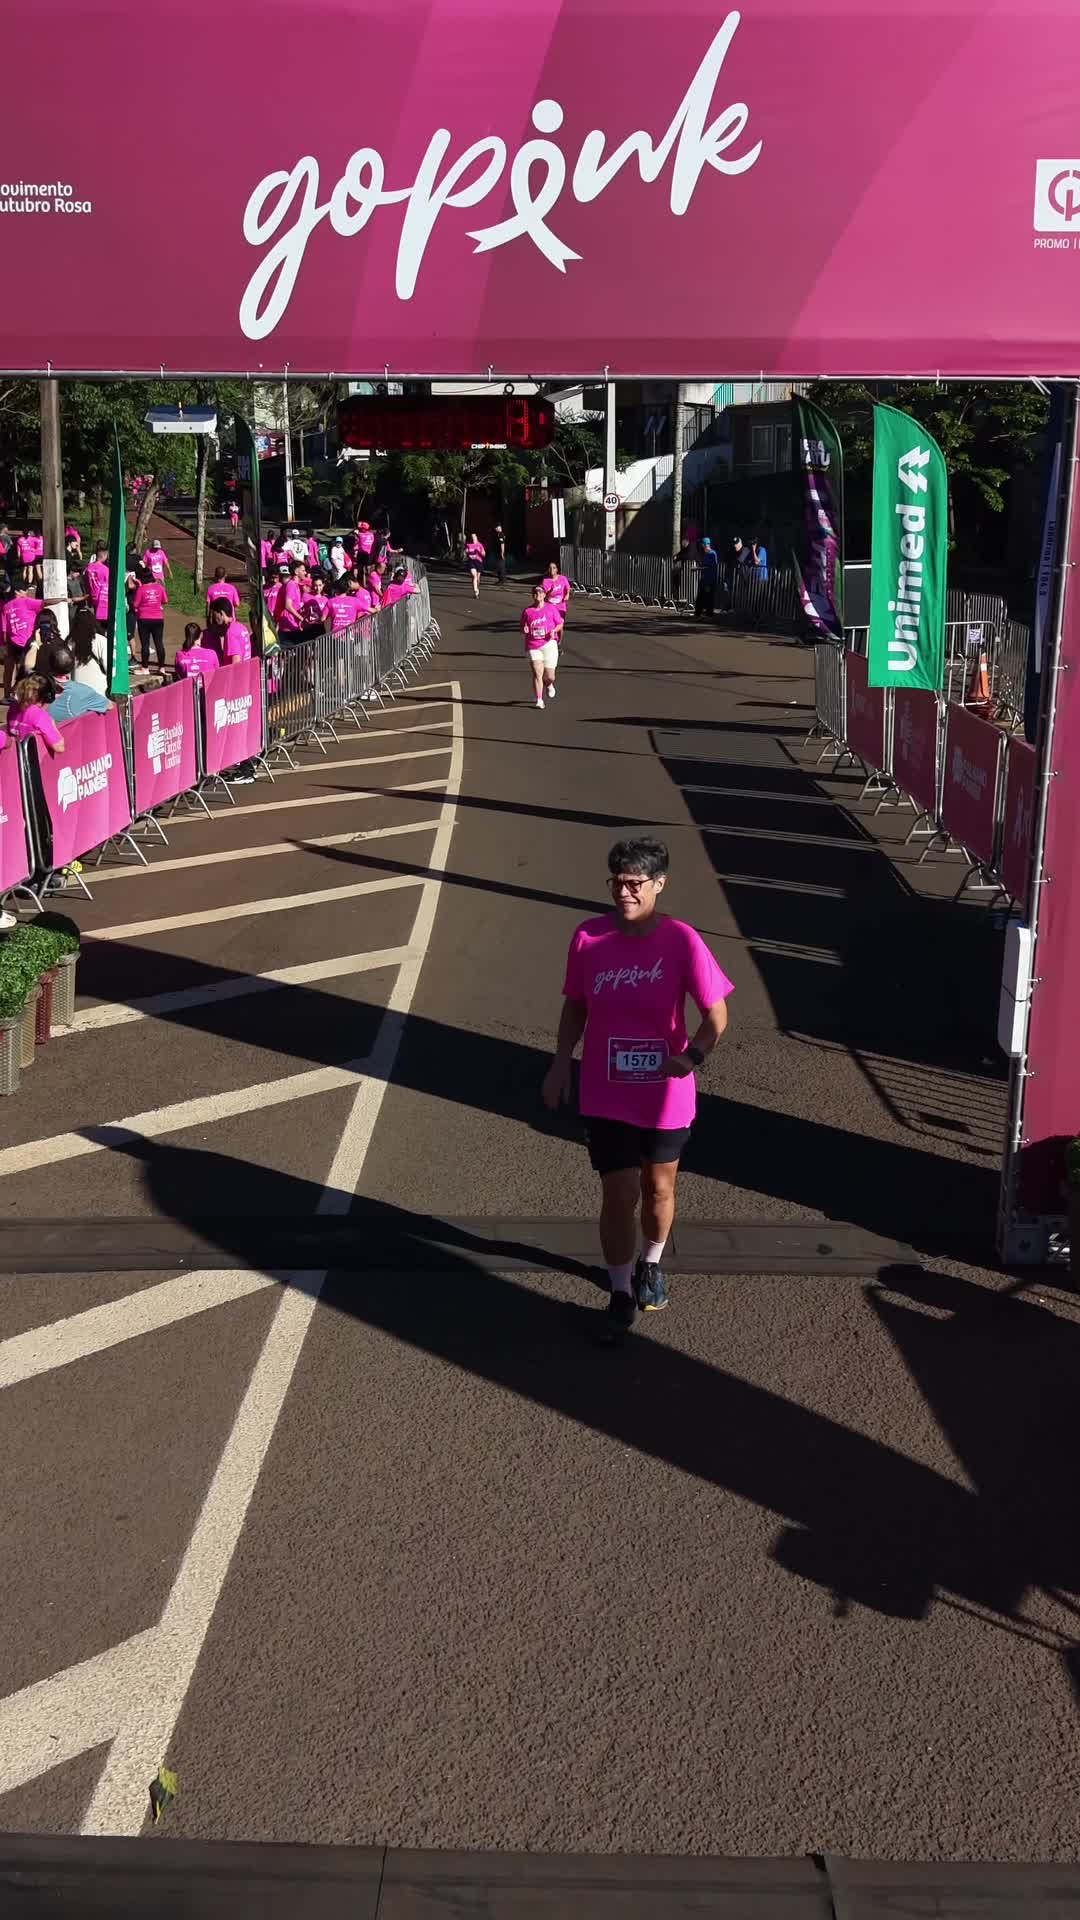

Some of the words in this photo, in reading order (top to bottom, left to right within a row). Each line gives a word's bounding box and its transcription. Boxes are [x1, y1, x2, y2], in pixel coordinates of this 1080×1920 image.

[240, 10, 763, 340] gopink
[0, 180, 73, 196] ovimento
[0, 197, 51, 213] utubro
[54, 198, 92, 213] Rosa
[1033, 238, 1070, 249] PROMO
[605, 496, 617, 504] 40
[887, 503, 926, 672] Unimed
[75, 753, 112, 785] PALHANO
[593, 958, 663, 995] gopink
[623, 1054, 657, 1066] 1578
